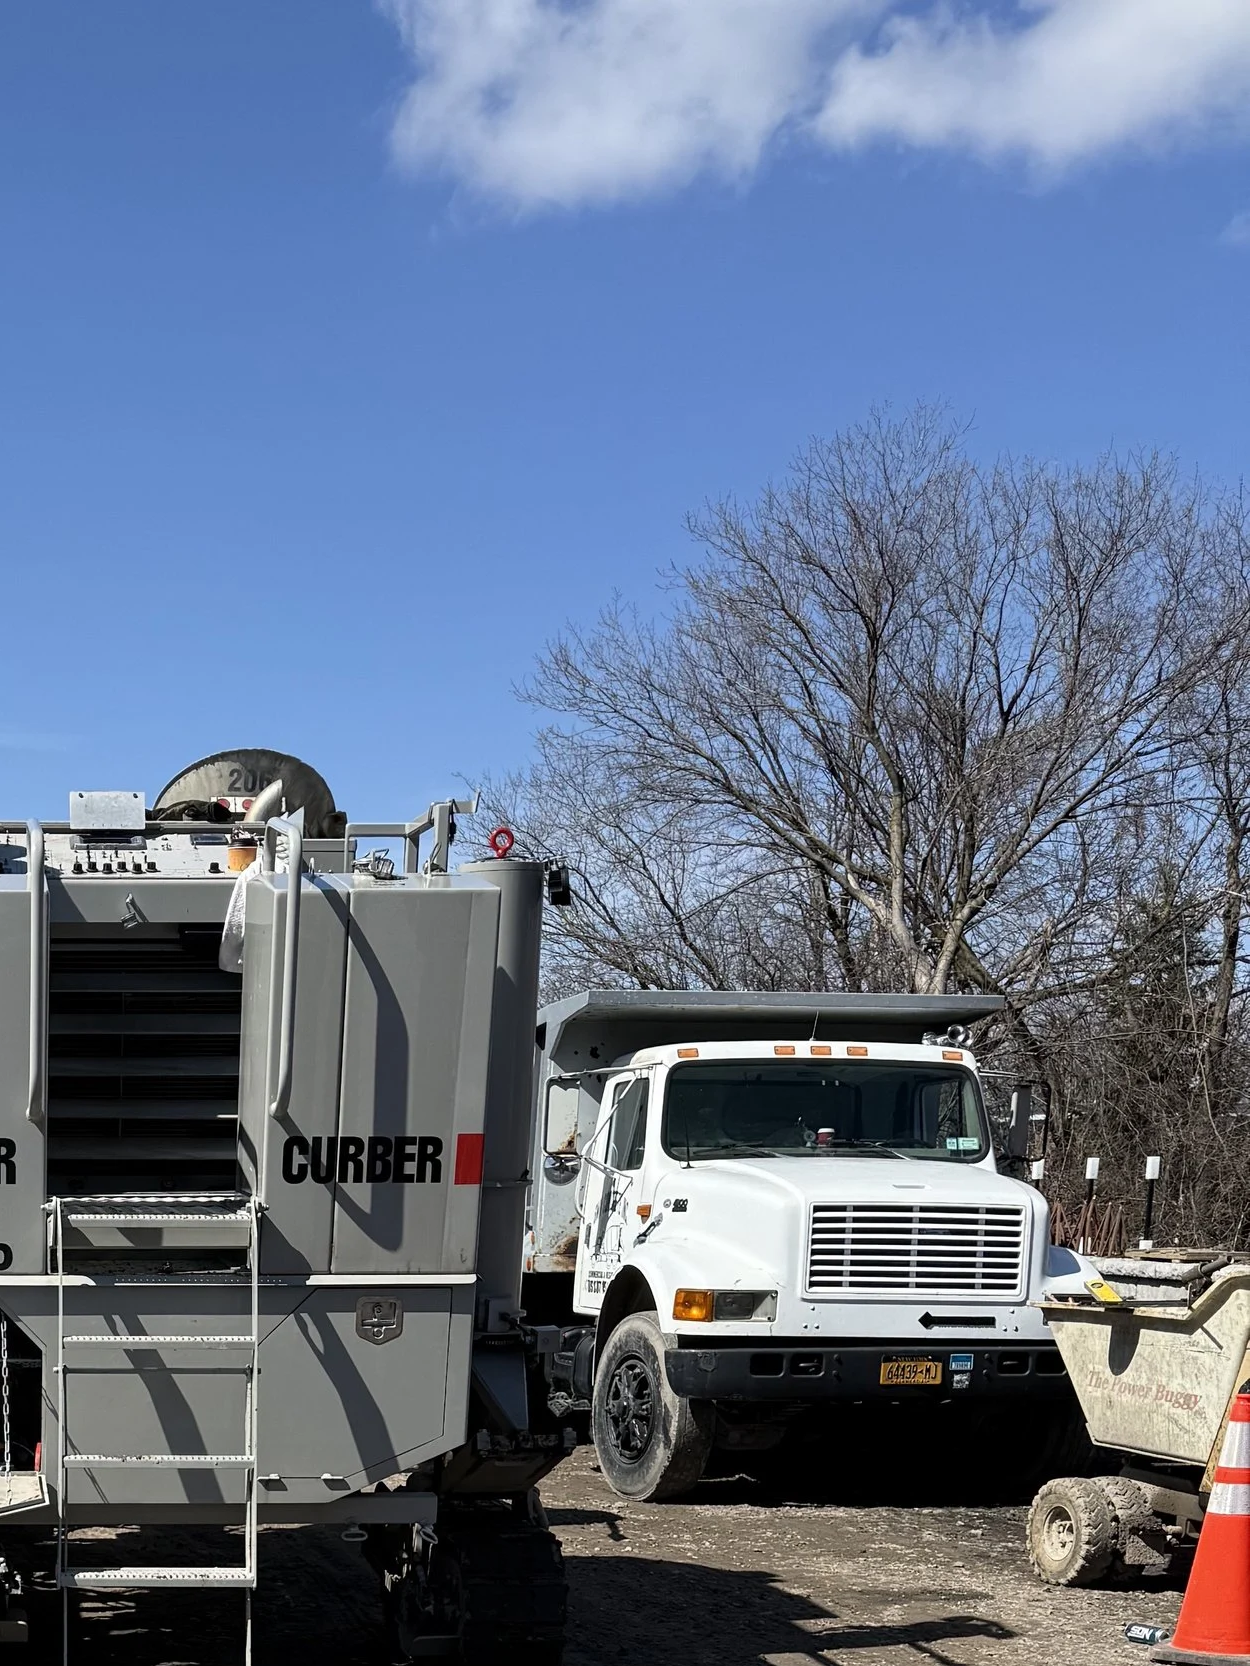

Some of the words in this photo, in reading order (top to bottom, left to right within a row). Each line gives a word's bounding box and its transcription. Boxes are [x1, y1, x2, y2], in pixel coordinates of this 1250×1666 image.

[282, 1135, 444, 1185] CURBER
[1087, 1370, 1110, 1391] The
[1110, 1377, 1153, 1399] Power
[1154, 1382, 1200, 1411] Buggy
